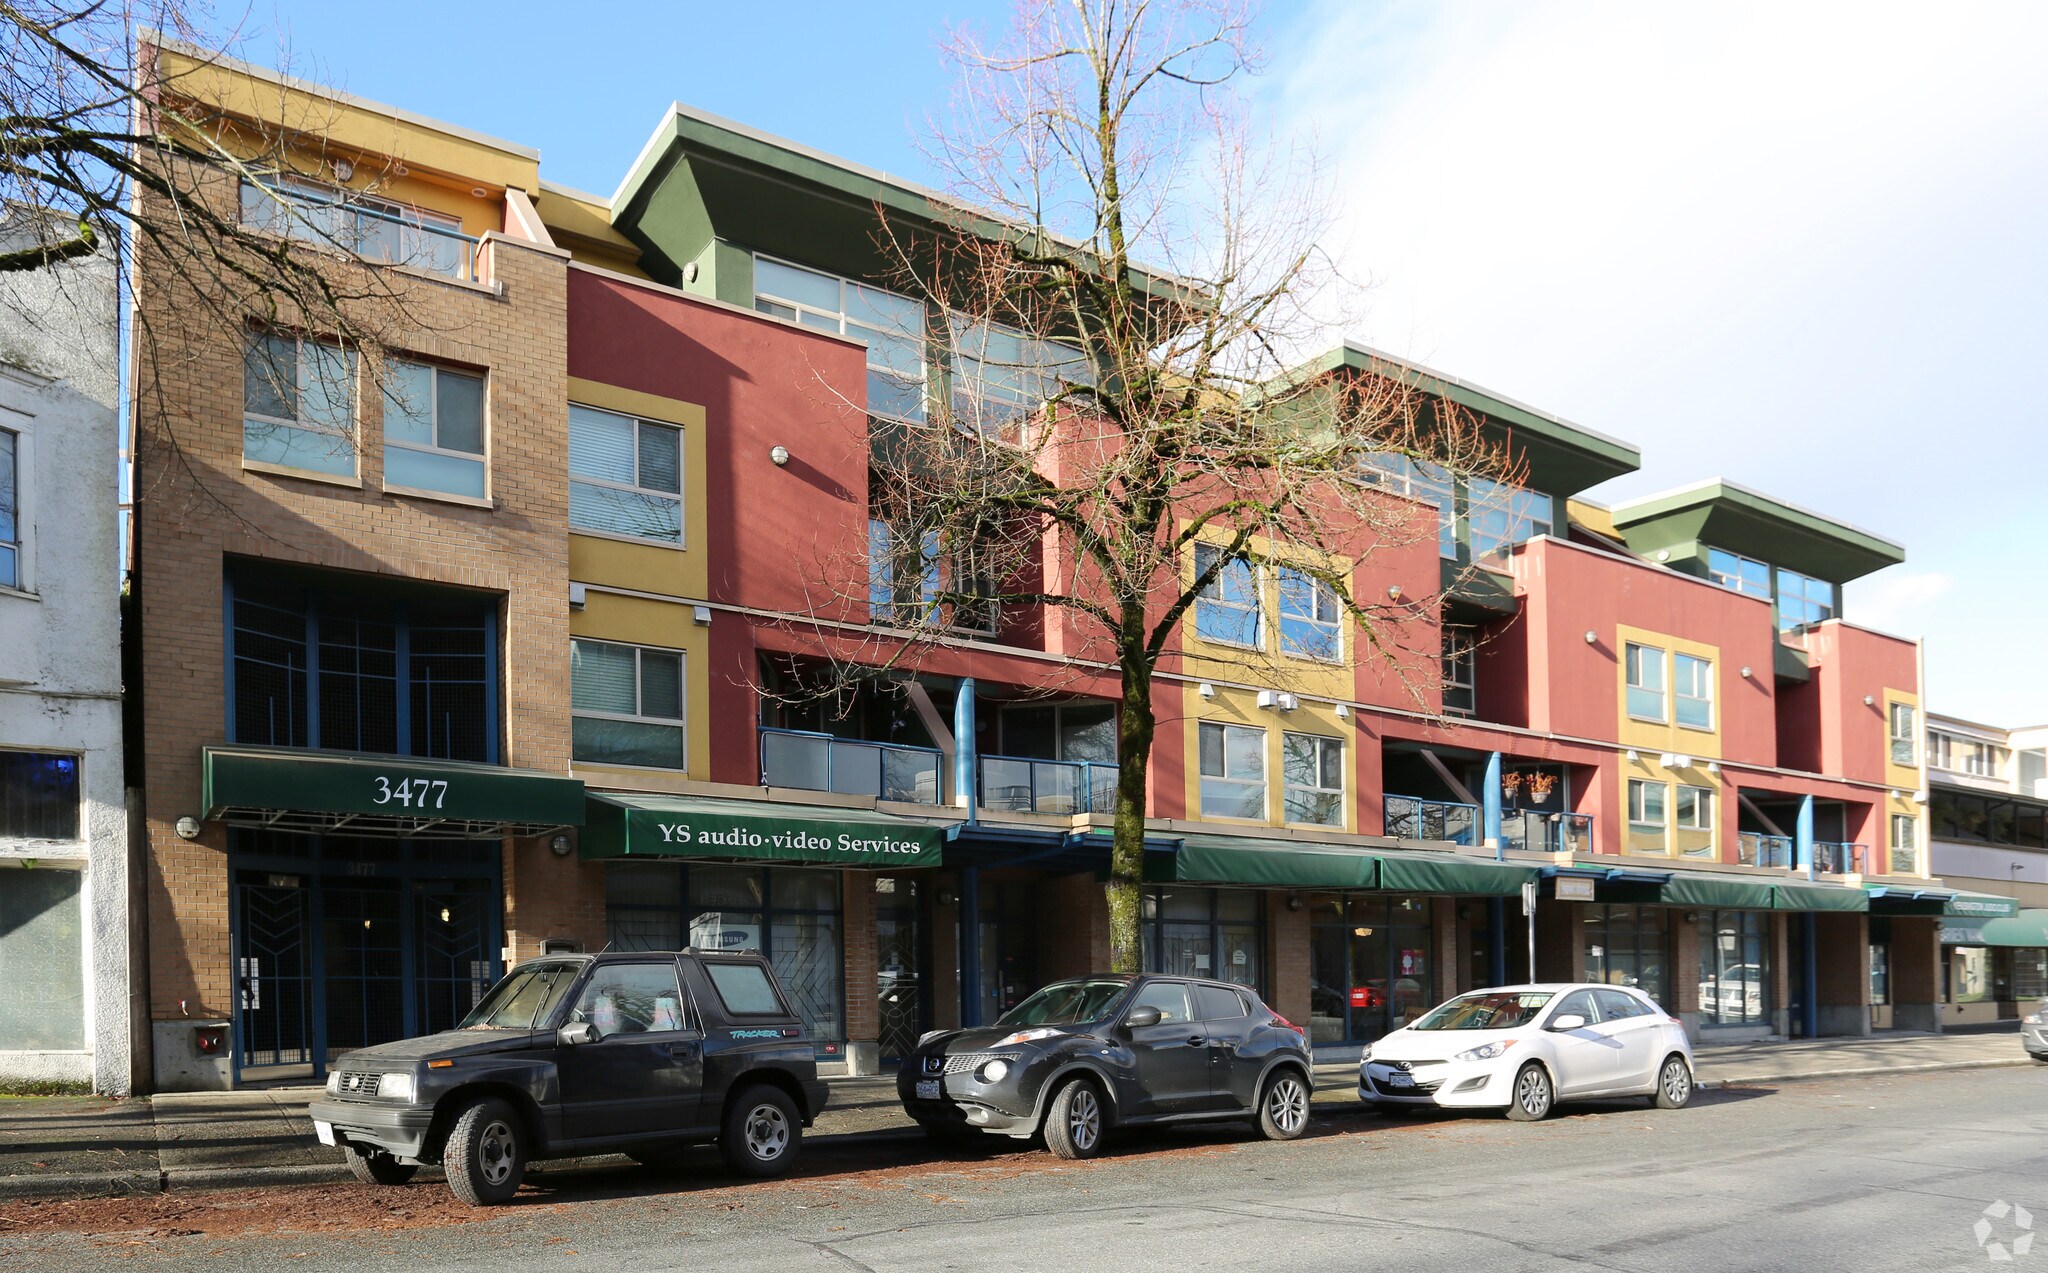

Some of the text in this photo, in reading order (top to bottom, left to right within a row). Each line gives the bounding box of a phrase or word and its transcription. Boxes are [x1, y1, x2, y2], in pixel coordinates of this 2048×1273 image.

[373, 776, 448, 809] 3477
[658, 823, 692, 843] YS
[837, 834, 921, 854] Services
[729, 1029, 780, 1040] TRACKER
